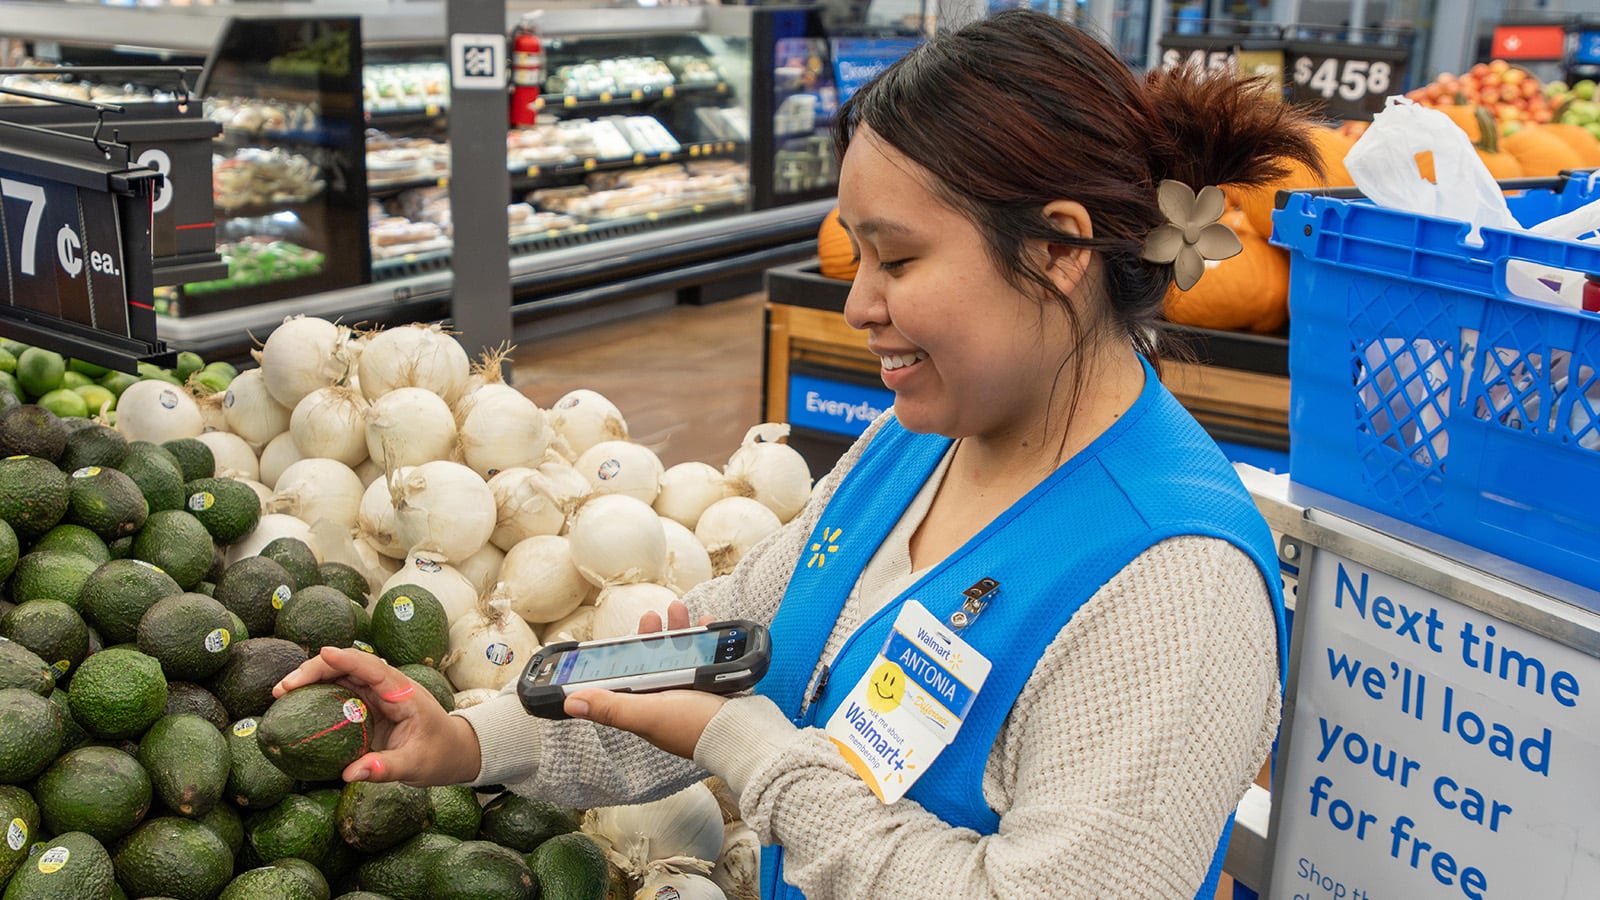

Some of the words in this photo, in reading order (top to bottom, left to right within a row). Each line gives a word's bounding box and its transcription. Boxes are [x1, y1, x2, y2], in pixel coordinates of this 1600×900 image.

[1162, 48, 1239, 85] $45
[1294, 57, 1391, 100] $458
[90, 250, 120, 276] ea.
[917, 627, 950, 661] Walmart
[1335, 562, 1444, 653] Next
[1460, 621, 1580, 708] time
[900, 647, 957, 702] ANTONIA
[845, 701, 904, 771] Walmart+
[848, 733, 880, 769] membership
[886, 725, 904, 745] about
[1442, 686, 1552, 777] load
[1317, 717, 1421, 788] your
[1433, 776, 1513, 833] car
[1309, 776, 1378, 841] for
[1390, 815, 1488, 900] free
[1297, 857, 1346, 900] Shop
